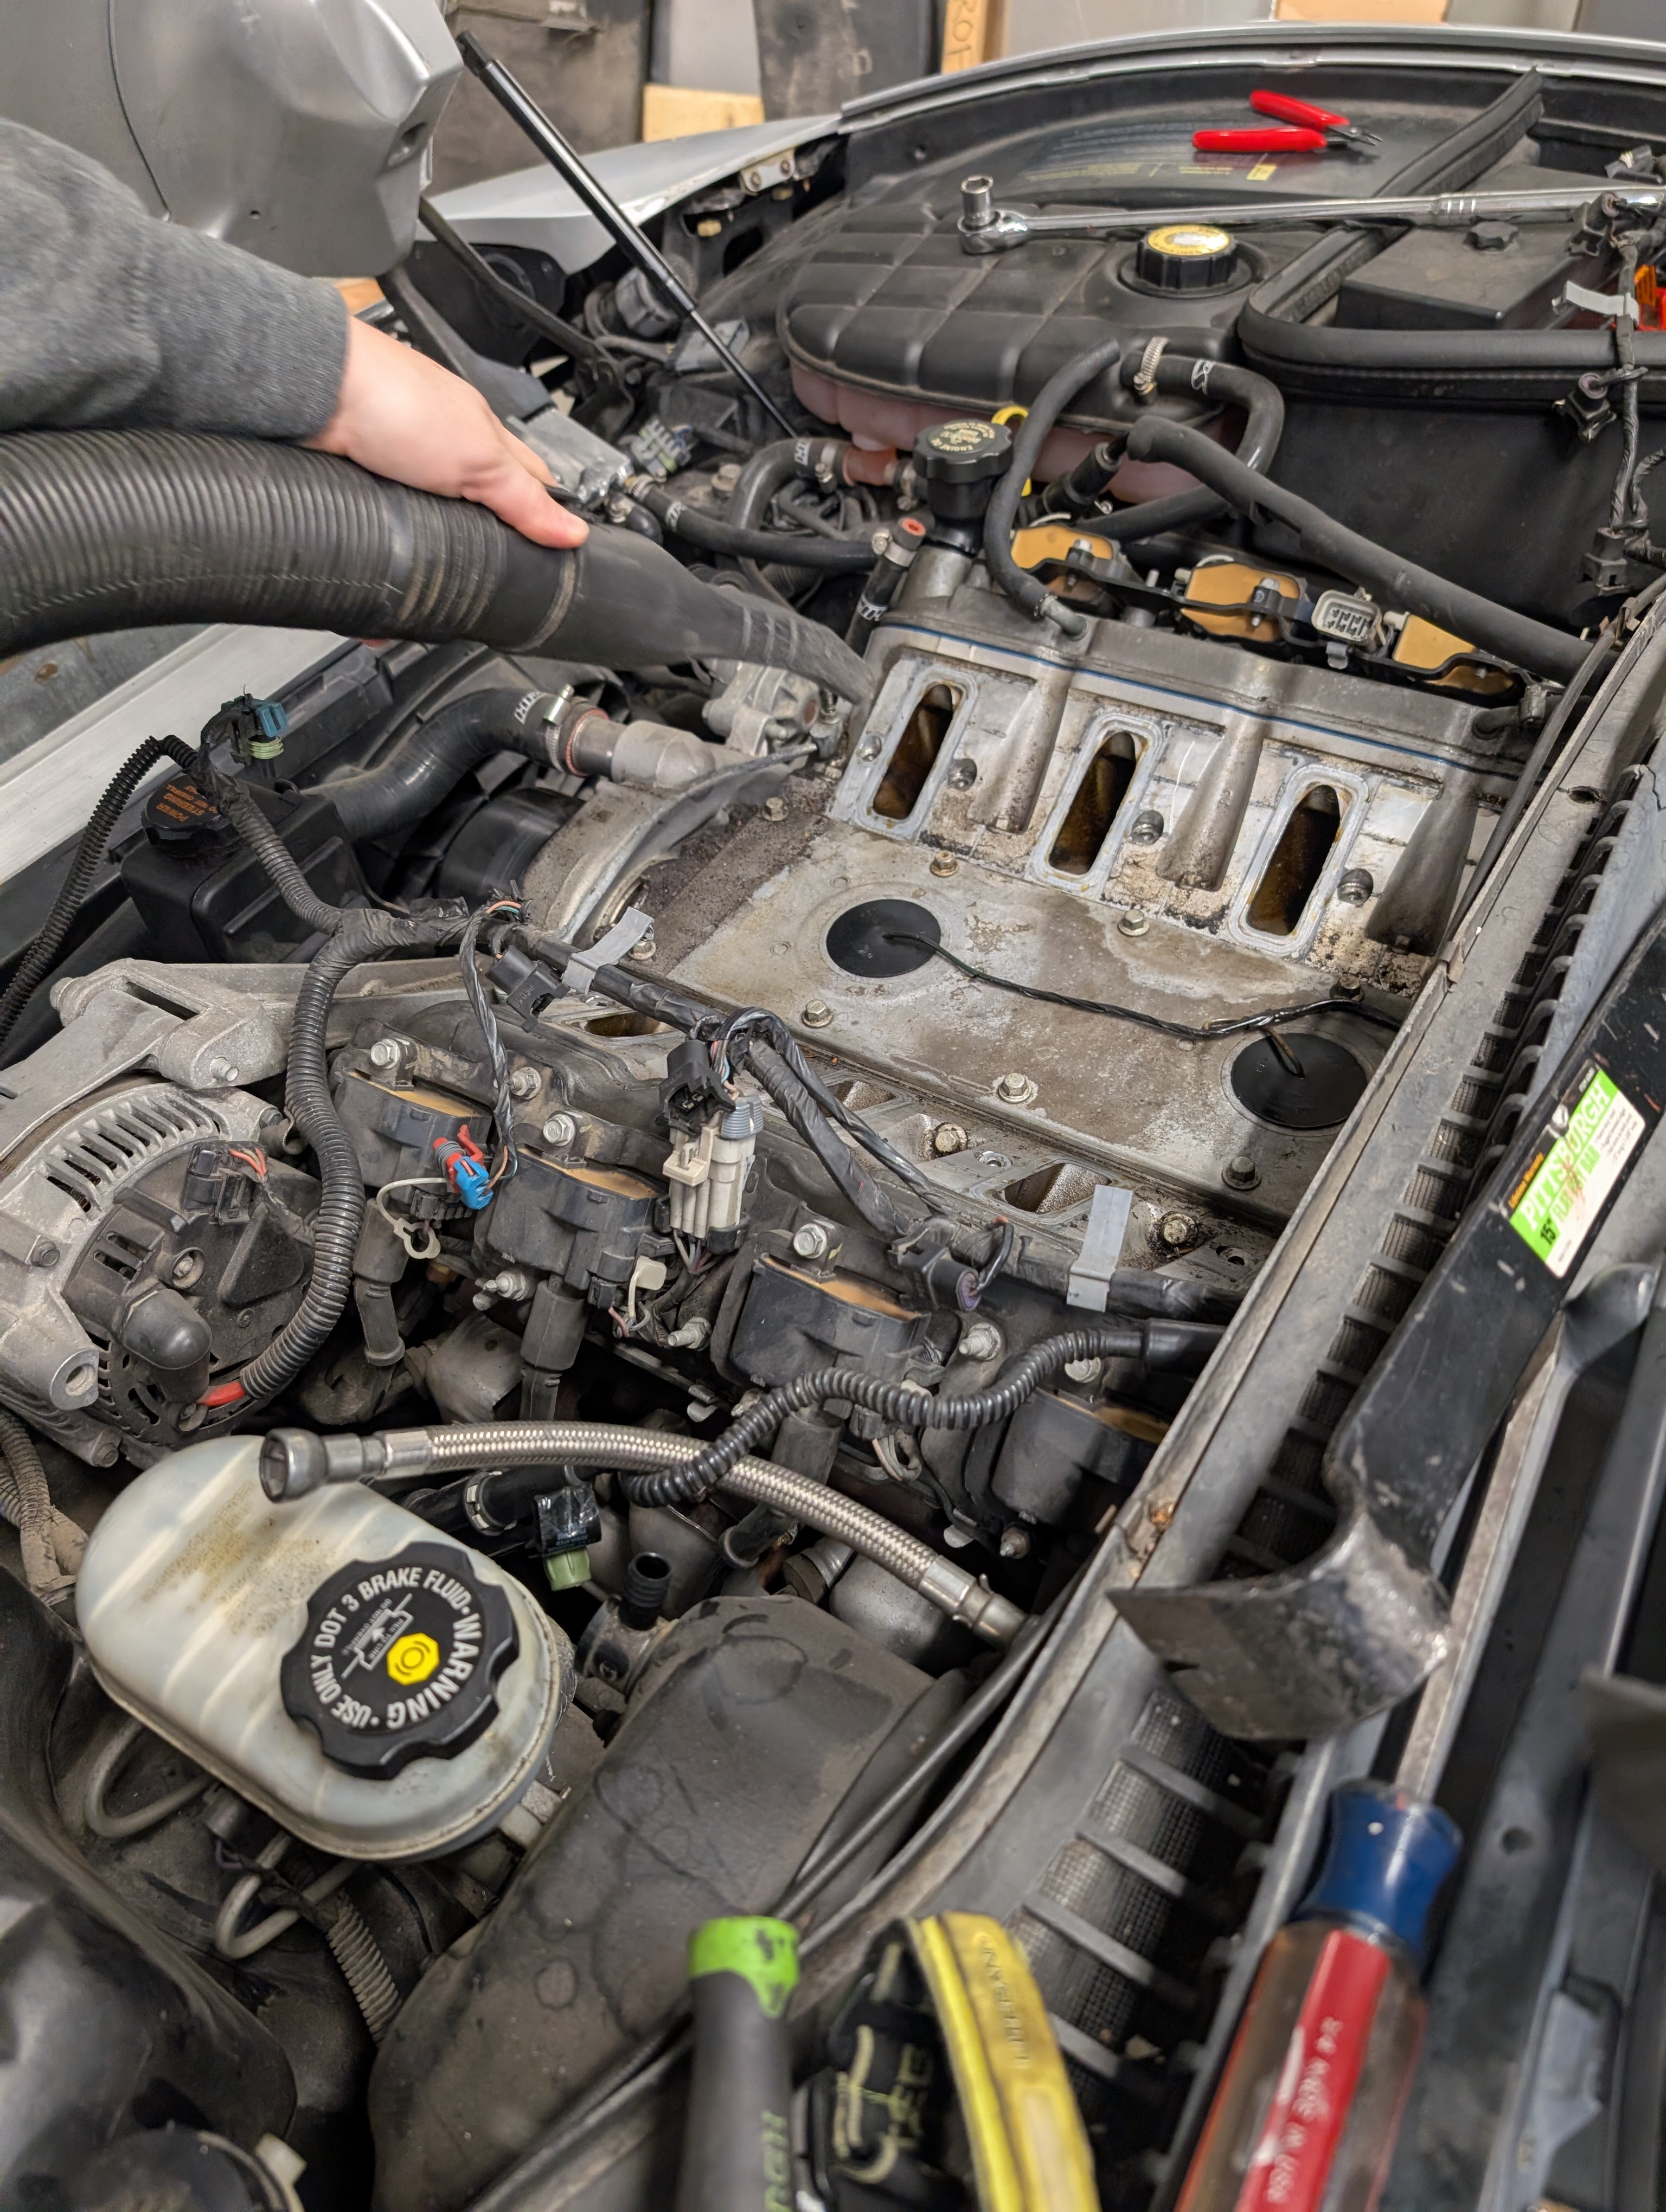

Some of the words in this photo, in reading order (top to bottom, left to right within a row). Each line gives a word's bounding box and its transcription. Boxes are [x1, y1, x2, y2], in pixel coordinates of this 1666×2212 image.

[156, 802, 189, 823] POWER
[163, 792, 205, 816] STEERING
[1520, 1079, 1611, 1232] PITTSBURGH
[341, 1594, 360, 1612] 3
[357, 1567, 422, 1602] BRAKE
[422, 1569, 472, 1609] FLUID
[313, 1607, 348, 1648] DOT
[310, 1655, 342, 1705] ONLY
[386, 1613, 483, 1730] WARNING
[330, 1695, 373, 1729] USE
